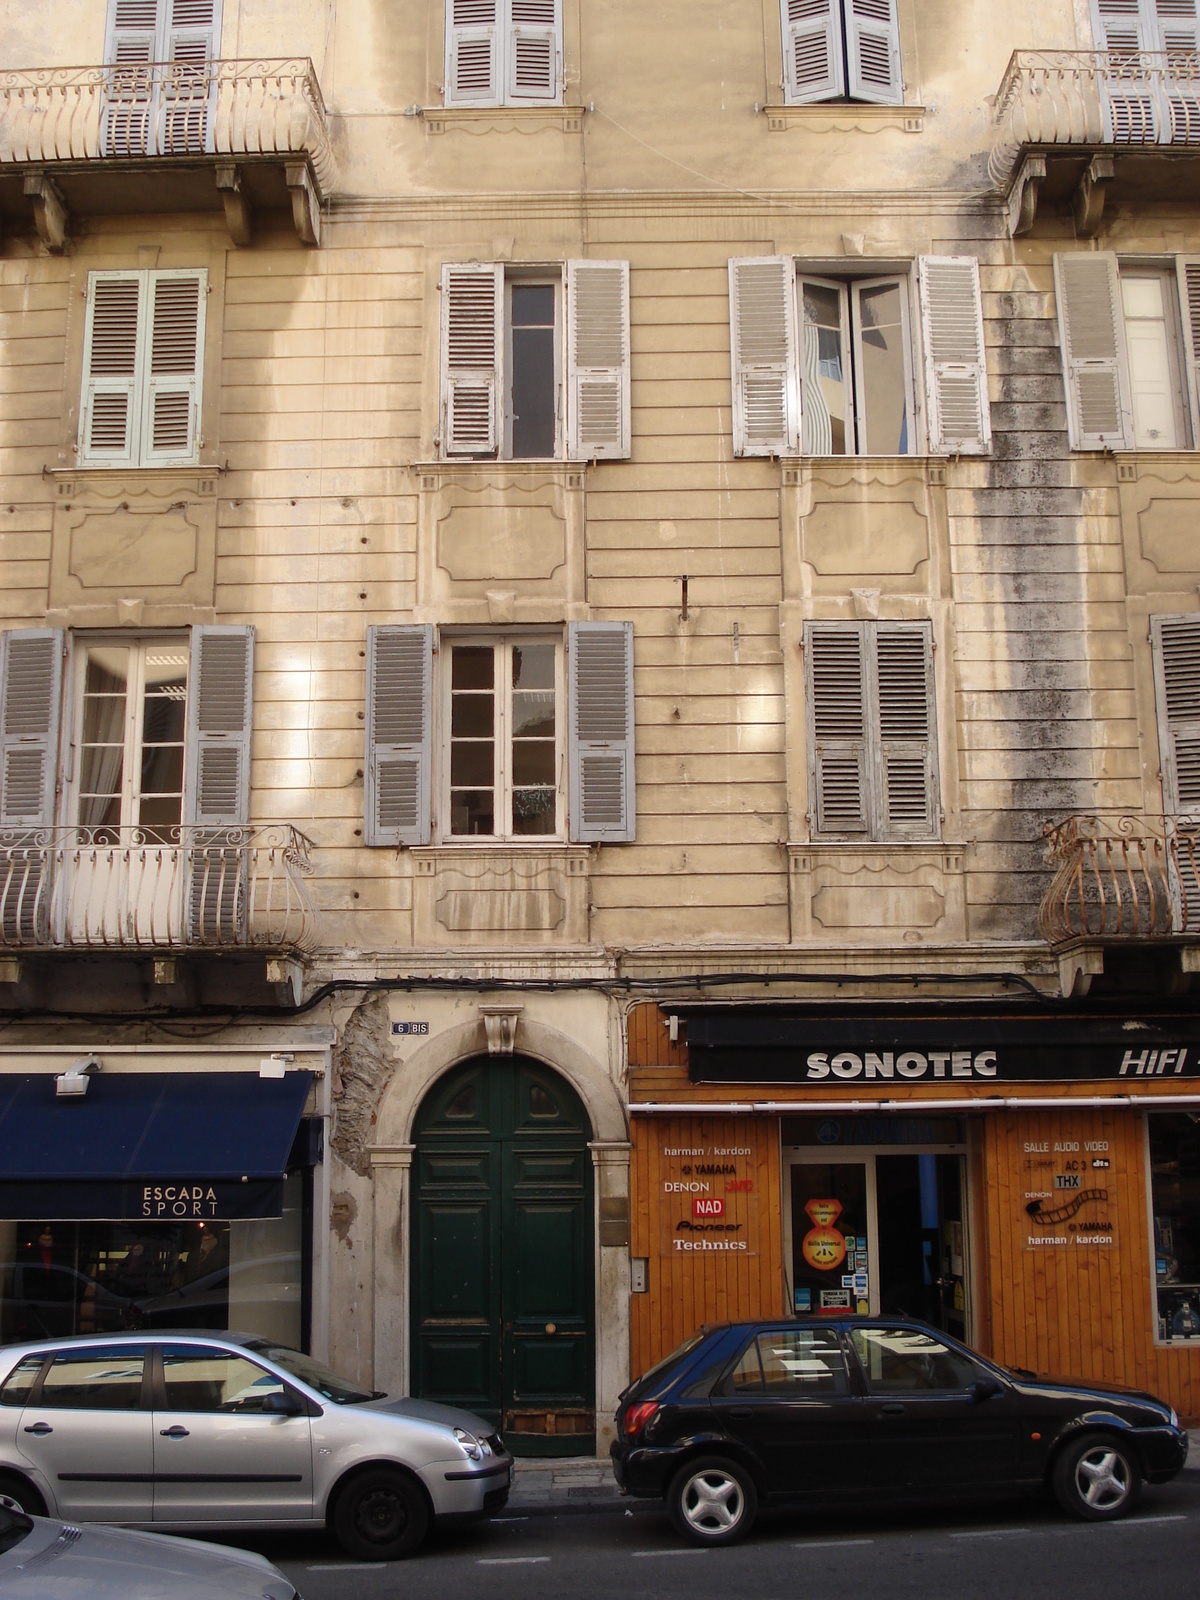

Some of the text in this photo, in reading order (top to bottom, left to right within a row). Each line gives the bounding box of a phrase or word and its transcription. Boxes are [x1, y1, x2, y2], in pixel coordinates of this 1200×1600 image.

[398, 1024, 427, 1033] 6 BIS
[806, 1051, 998, 1079] SONOTEC
[1118, 1048, 1188, 1075] HIFI
[842, 1119, 935, 1143] YAMAHA
[664, 1147, 704, 1156] harman
[714, 1146, 751, 1155] kardon
[1024, 1141, 1109, 1153] SALLE AUDIO VIDEO
[1065, 1160, 1087, 1171] AC 3
[1092, 1159, 1110, 1168] dts
[694, 1164, 736, 1175] YAMAHA
[725, 1180, 753, 1192] JVC
[1056, 1175, 1079, 1187] THX
[664, 1182, 710, 1192] DENON
[143, 1186, 217, 1200] ESCADA
[142, 1201, 218, 1216] SPORT
[696, 1200, 722, 1214] NAD
[676, 1220, 743, 1231] Pioneer
[1079, 1222, 1113, 1231] YAMAHA
[673, 1239, 747, 1250] Technics
[1028, 1236, 1067, 1245] harman
[1076, 1235, 1112, 1244] kardon
